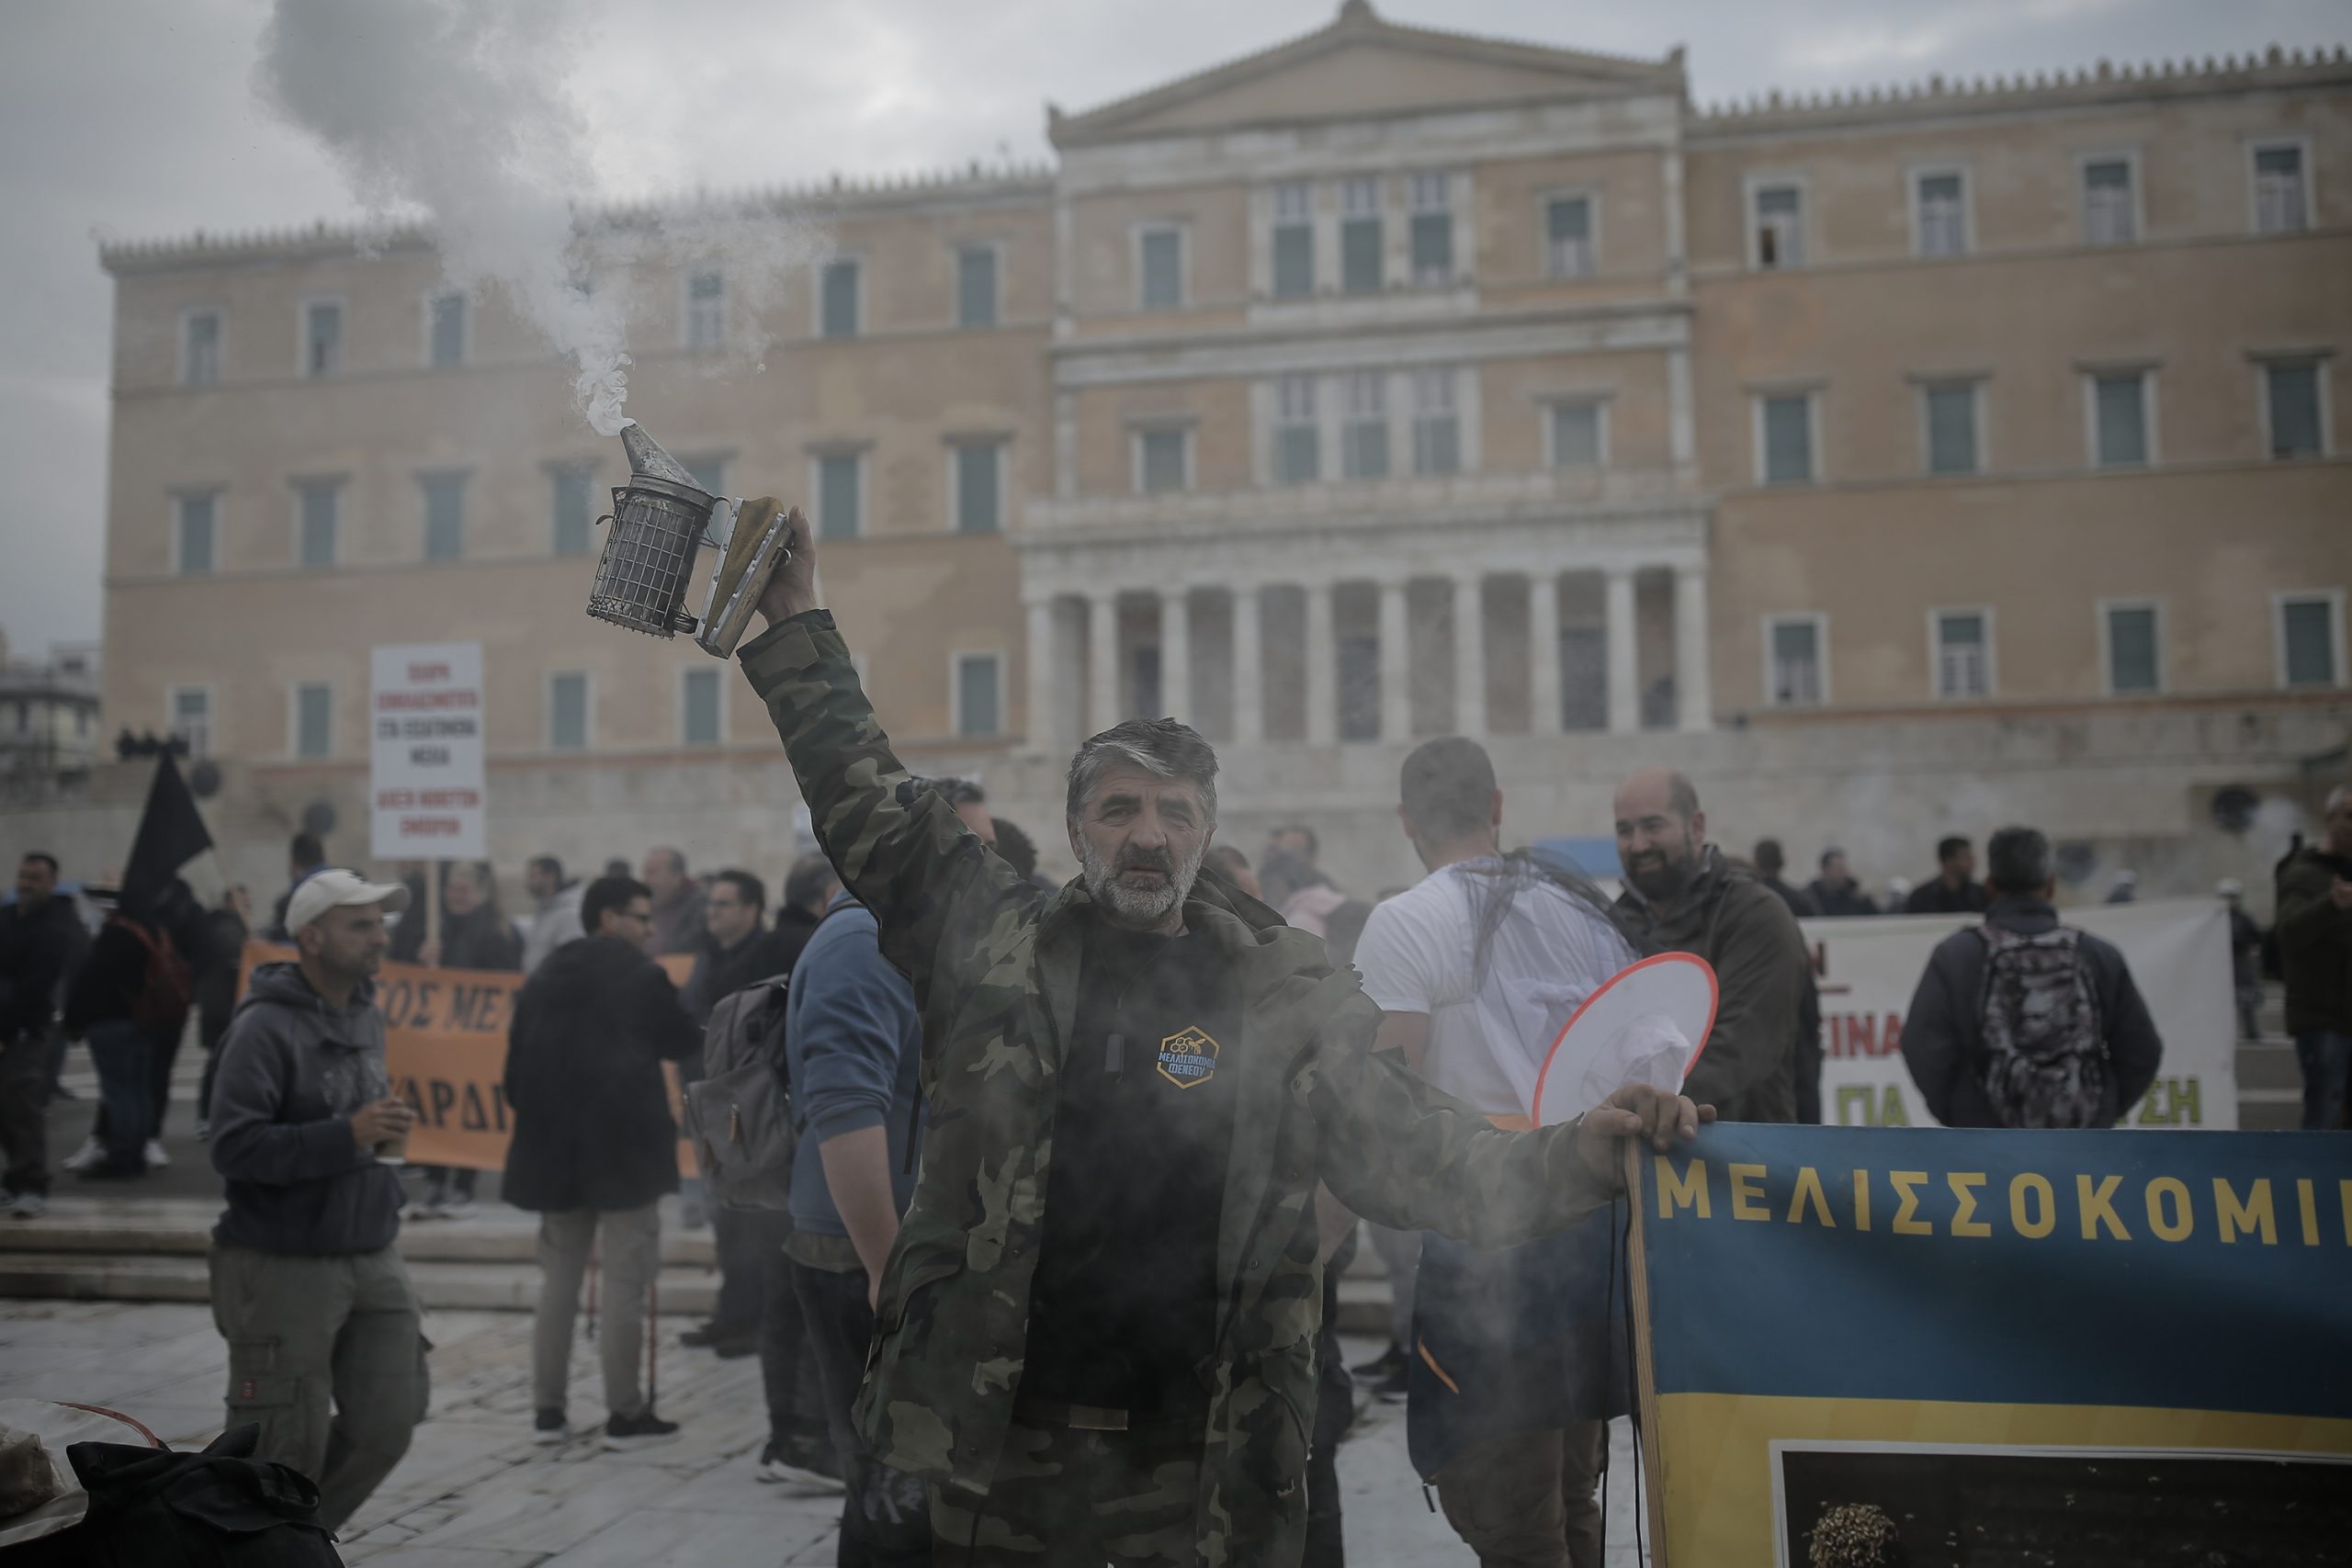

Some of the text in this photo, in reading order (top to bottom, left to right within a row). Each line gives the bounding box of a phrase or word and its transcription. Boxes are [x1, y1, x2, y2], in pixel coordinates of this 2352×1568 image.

[1818, 1014, 1903, 1057] ΙΝΑ
[1168, 1063, 1205, 1077] ΦΕΝΕΟΥ
[2116, 1078, 2202, 1127] ΣΗ
